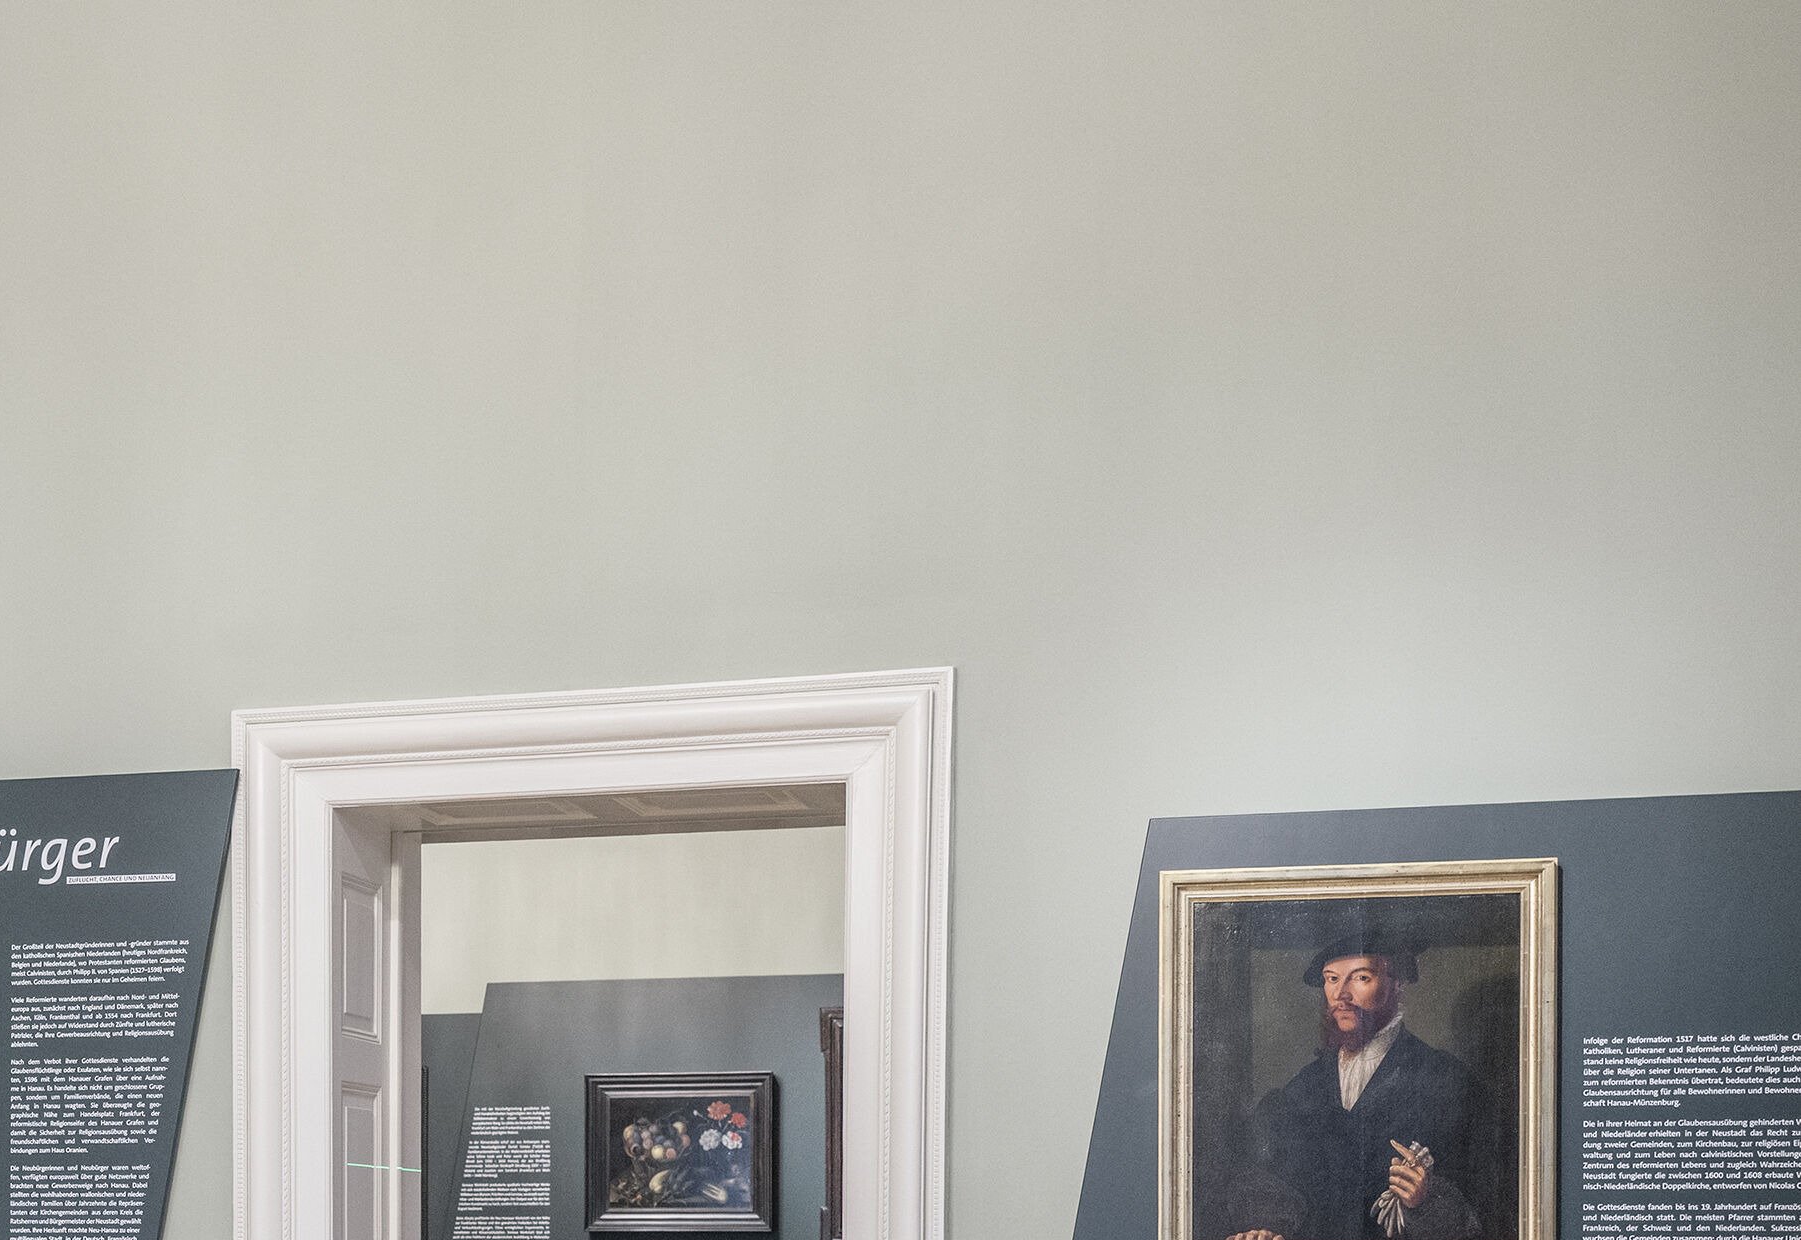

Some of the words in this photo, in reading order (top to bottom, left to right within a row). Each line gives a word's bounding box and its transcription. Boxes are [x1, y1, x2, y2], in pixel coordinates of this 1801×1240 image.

[1583, 1037, 1609, 1046] Infolge
[1611, 1036, 1624, 1044] der
[1627, 1036, 1673, 1044] Reformation
[1676, 1035, 1694, 1043] 1517
[1720, 1034, 1736, 1042] sich
[1738, 1034, 1751, 1042] die
[1583, 1047, 1624, 1055] Katholiken,
[1686, 1045, 1731, 1053] Reformierte
[1733, 1044, 1778, 1053] (Calvinisten)
[1604, 1057, 1624, 1065] keine
[1624, 1056, 1683, 1066] Religionsfreiheit
[1683, 1056, 1697, 1064] wie
[1698, 1056, 1722, 1064] heute,
[1722, 1055, 1752, 1063] sondern
[1753, 1055, 1766, 1063] der
[1583, 1068, 1601, 1076] über
[1602, 1068, 1615, 1076] die
[1617, 1067, 1646, 1077] Religion
[1648, 1067, 1671, 1075] seiner
[1720, 1066, 1733, 1074] Als
[1735, 1065, 1753, 1073] Graf
[1755, 1065, 1781, 1074] Philipp
[1601, 1078, 1647, 1086] reformierten
[1649, 1077, 1689, 1085] Bekenntnis
[1691, 1077, 1724, 1085] übertrat,
[1765, 1076, 1781, 1084] dies
[1582, 1089, 1659, 1097] Glaubensausrichtung
[1660, 1087, 1672, 1096] für
[1688, 1087, 1746, 1095] Bewohnerinnen
[1583, 1099, 1606, 1107] schaft
[1607, 1099, 1681, 1107] Hanau-Münzenburg.
[1582, 1203, 1595, 1211] Die
[1596, 1203, 1646, 1211] Gottesdienste
[1647, 1203, 1673, 1211] fanden
[1675, 1203, 1686, 1211] bis
[1688, 1203, 1699, 1211] ins
[1701, 1203, 1712, 1211] 19.
[1713, 1203, 1757, 1211] Jahrhundert
[1679, 1213, 1692, 1221] Die
[1728, 1213, 1754, 1221] Pfarrer
[1582, 1224, 1622, 1232] Frankreich,
[1625, 1224, 1639, 1232] der
[1642, 1224, 1672, 1232] Schweiz
[1676, 1224, 1692, 1232] und
[1695, 1224, 1711, 1232] den
[1715, 1224, 1767, 1232] Niederlanden.
